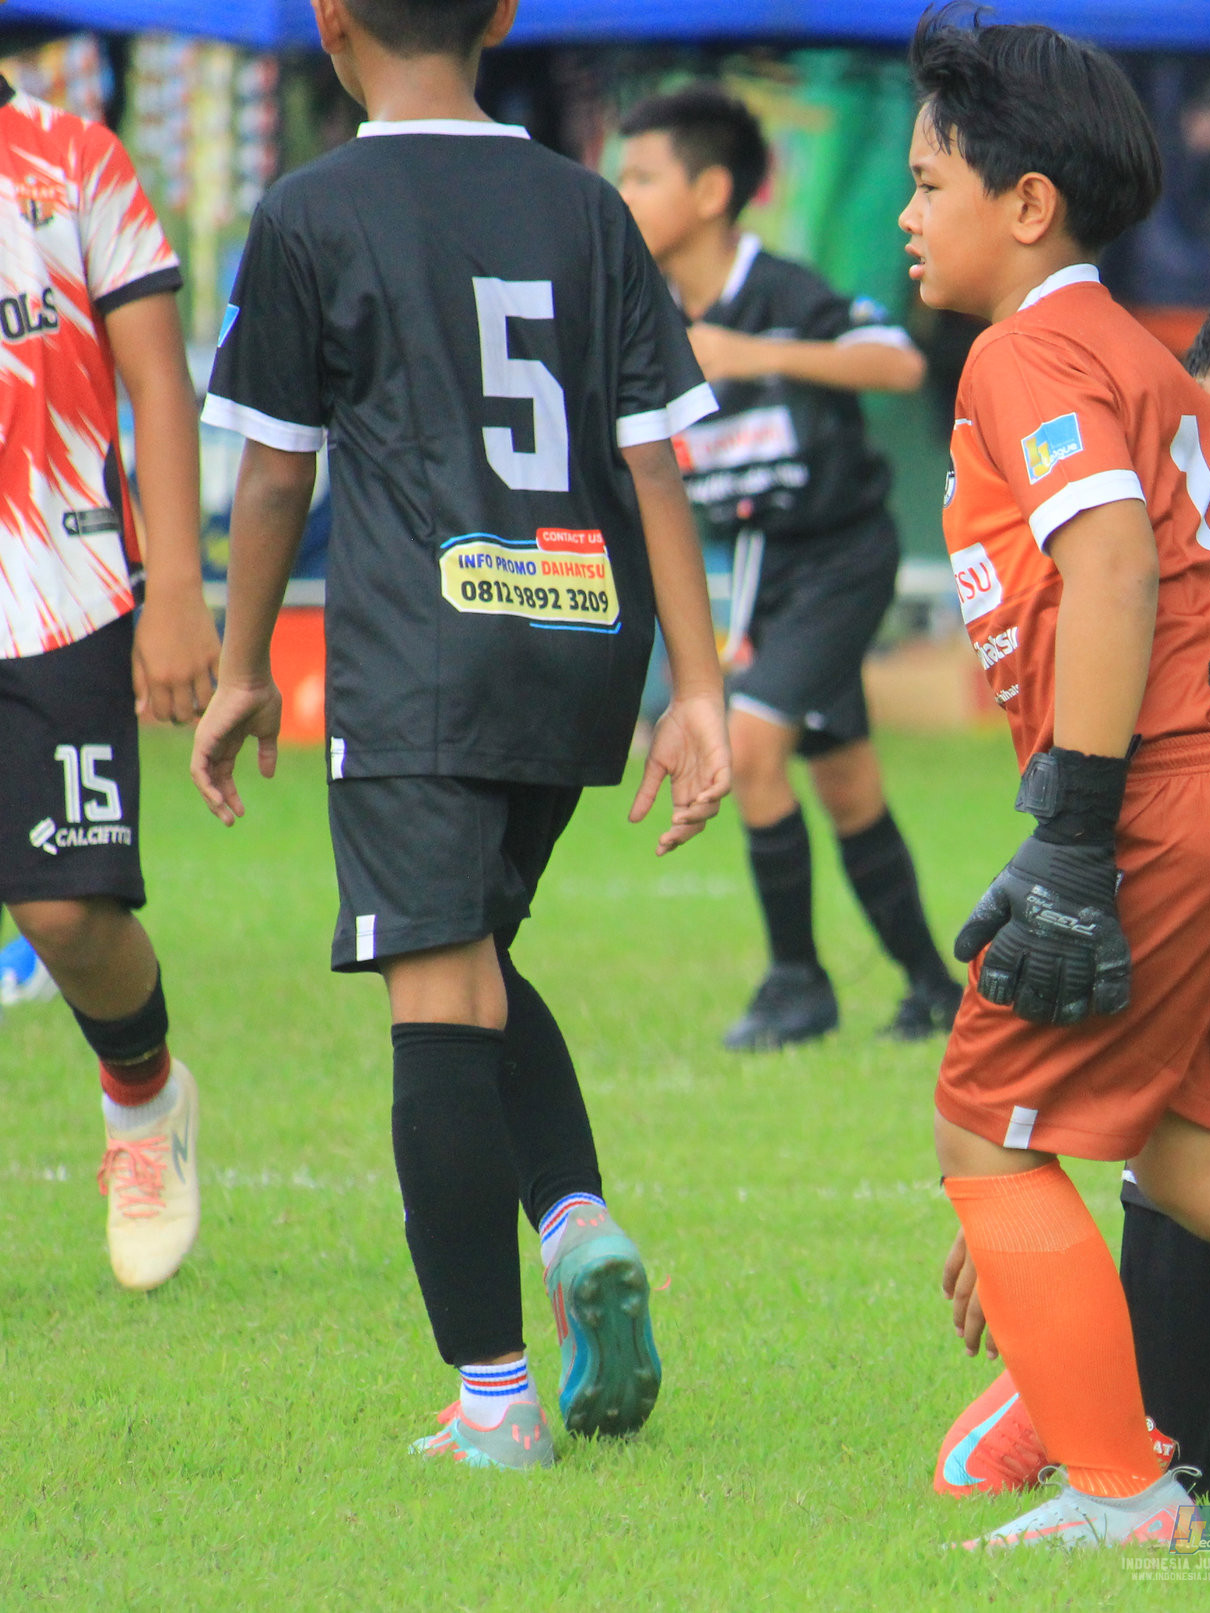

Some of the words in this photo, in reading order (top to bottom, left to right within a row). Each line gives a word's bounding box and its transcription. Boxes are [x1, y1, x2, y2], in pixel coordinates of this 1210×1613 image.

[0, 287, 59, 340] OLS
[472, 277, 570, 492] 5
[542, 532, 585, 544] CONTACT
[588, 533, 603, 544] US
[458, 554, 493, 569] INFO
[496, 556, 537, 576] PROMO
[541, 560, 605, 579] DAIHATSU
[461, 580, 514, 604] 0812
[514, 585, 562, 610] 9892
[566, 588, 609, 613] 3209
[54, 744, 123, 823] 15
